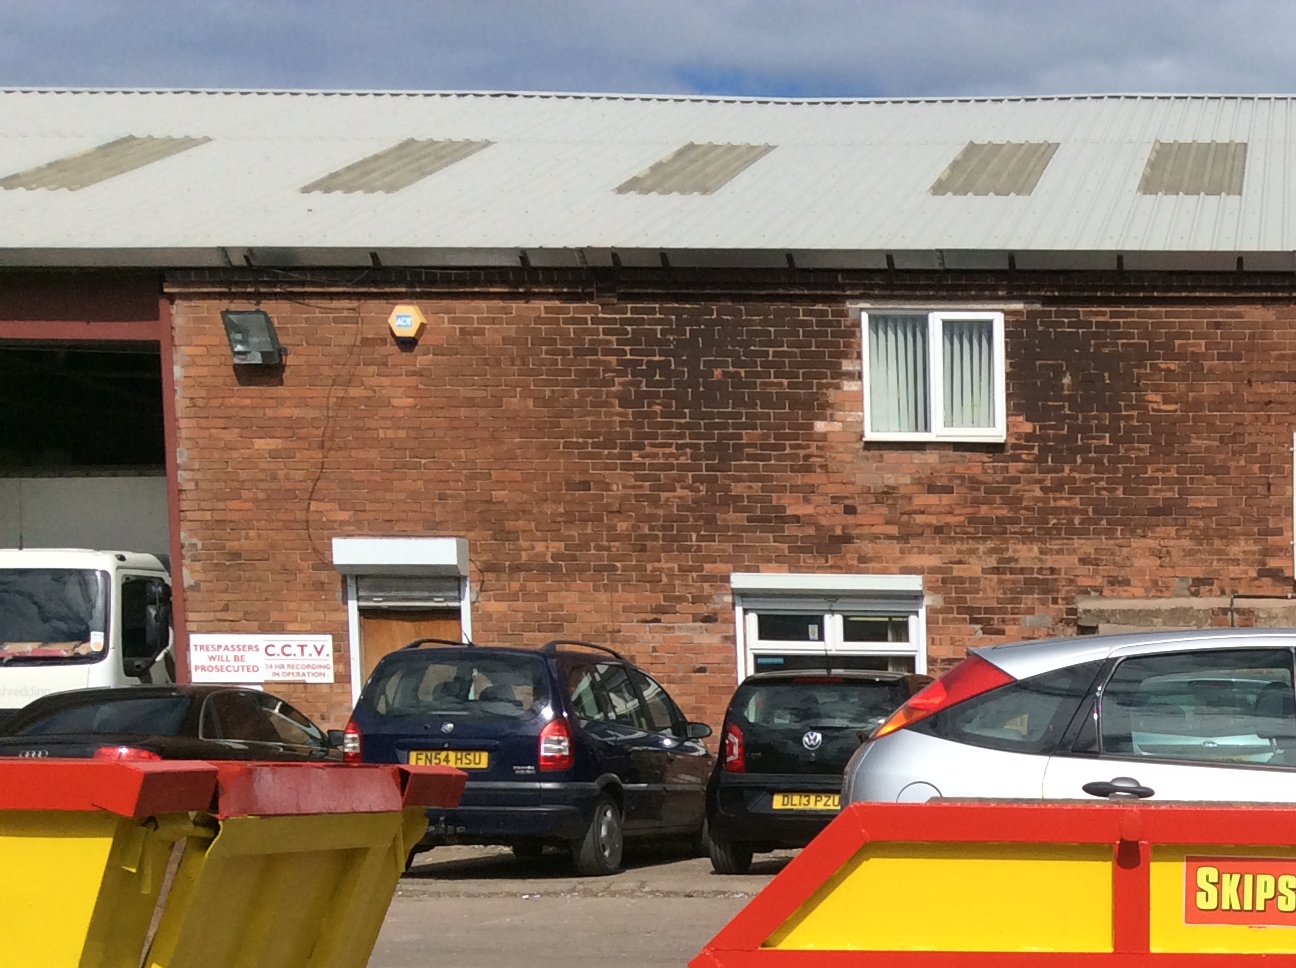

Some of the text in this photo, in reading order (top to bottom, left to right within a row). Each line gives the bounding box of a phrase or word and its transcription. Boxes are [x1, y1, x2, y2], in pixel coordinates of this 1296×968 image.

[395, 317, 413, 326] ADT
[193, 644, 260, 652] TRESPASSERS
[264, 644, 330, 657] C.C.T.V.
[208, 654, 231, 662] WILL
[194, 664, 260, 673] PROSECUTED
[415, 752, 481, 765] FN54 HSU
[781, 794, 811, 807] DL13
